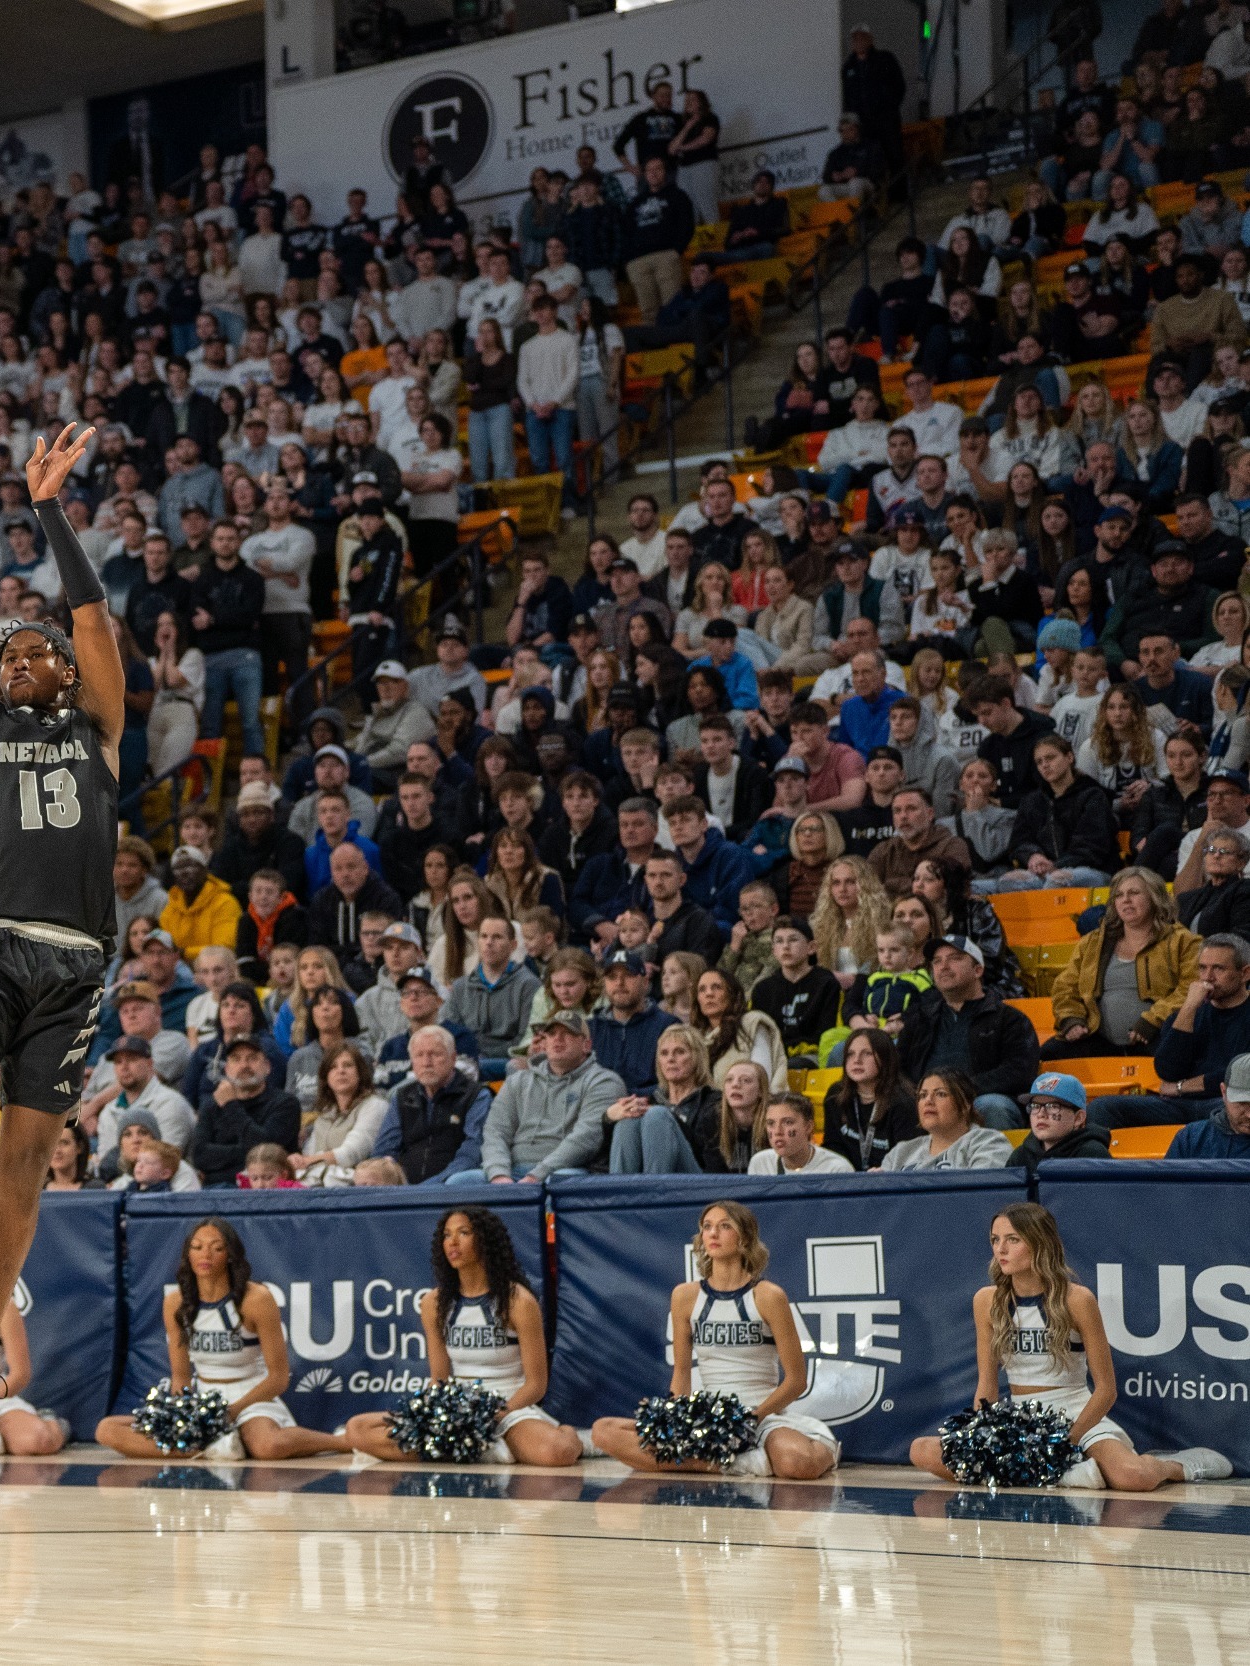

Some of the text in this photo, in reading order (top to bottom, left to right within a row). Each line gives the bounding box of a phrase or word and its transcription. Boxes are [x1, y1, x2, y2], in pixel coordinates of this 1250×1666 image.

[282, 45, 299, 73] L
[512, 50, 702, 132] Fisher
[505, 133, 573, 161] Home
[0, 739, 90, 763] NEVADA
[19, 767, 81, 830] 13
[188, 1330, 244, 1353] GGIES
[693, 1320, 763, 1346] AGGIES
[1124, 1371, 1248, 1403] division
